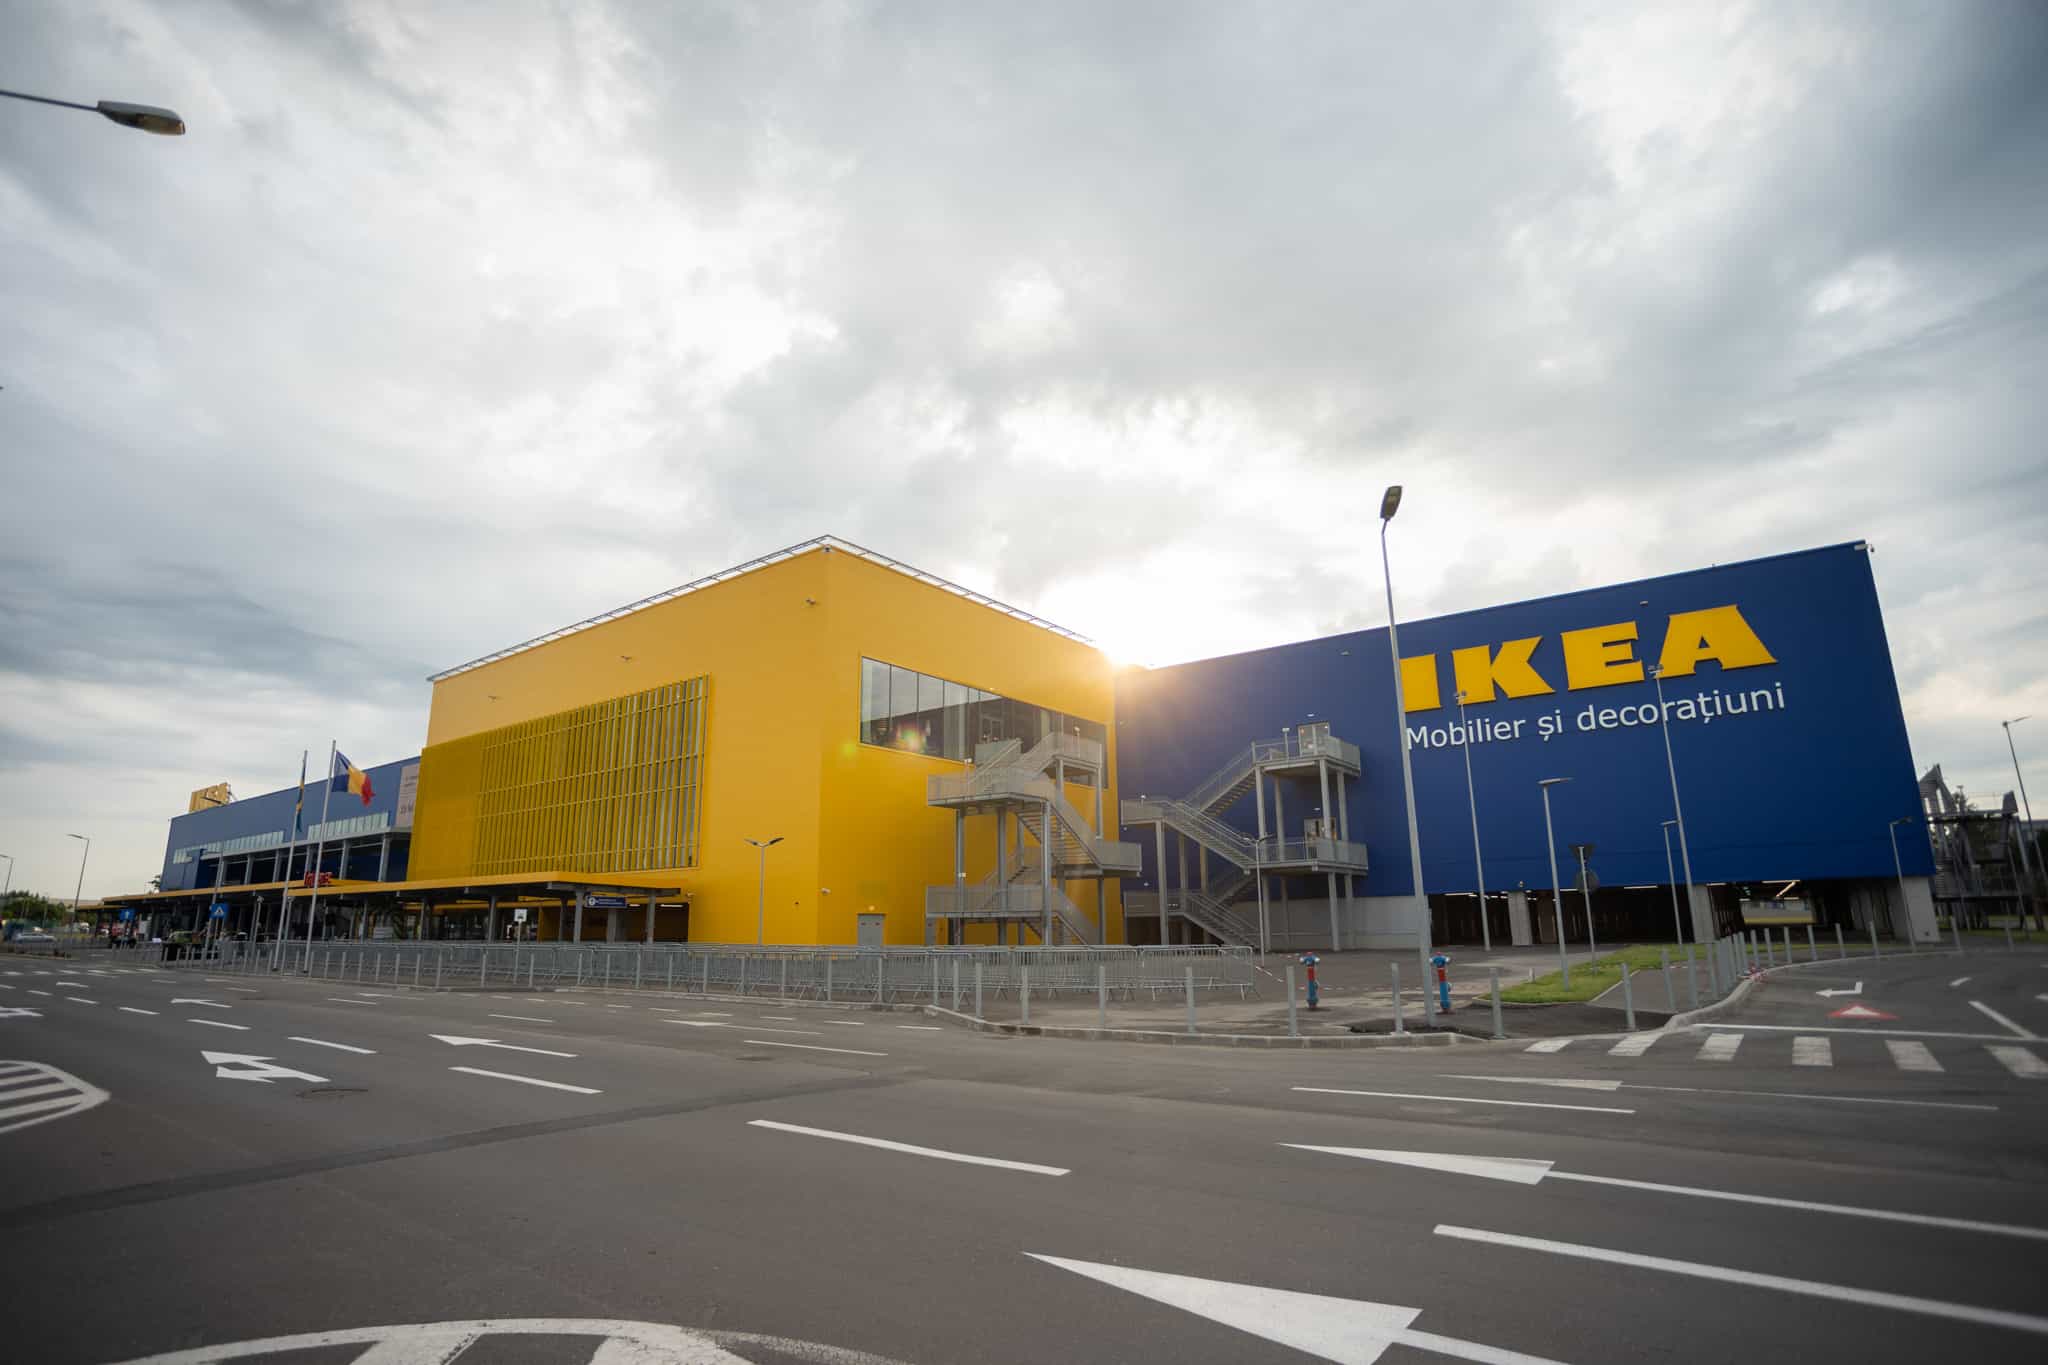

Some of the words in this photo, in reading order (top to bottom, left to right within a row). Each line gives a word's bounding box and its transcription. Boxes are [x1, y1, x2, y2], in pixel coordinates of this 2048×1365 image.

[1399, 604, 1776, 713] IKEA
[1406, 717, 1526, 750] Mobilier
[1538, 709, 1563, 742] și
[1577, 682, 1785, 731] decorațiuni
